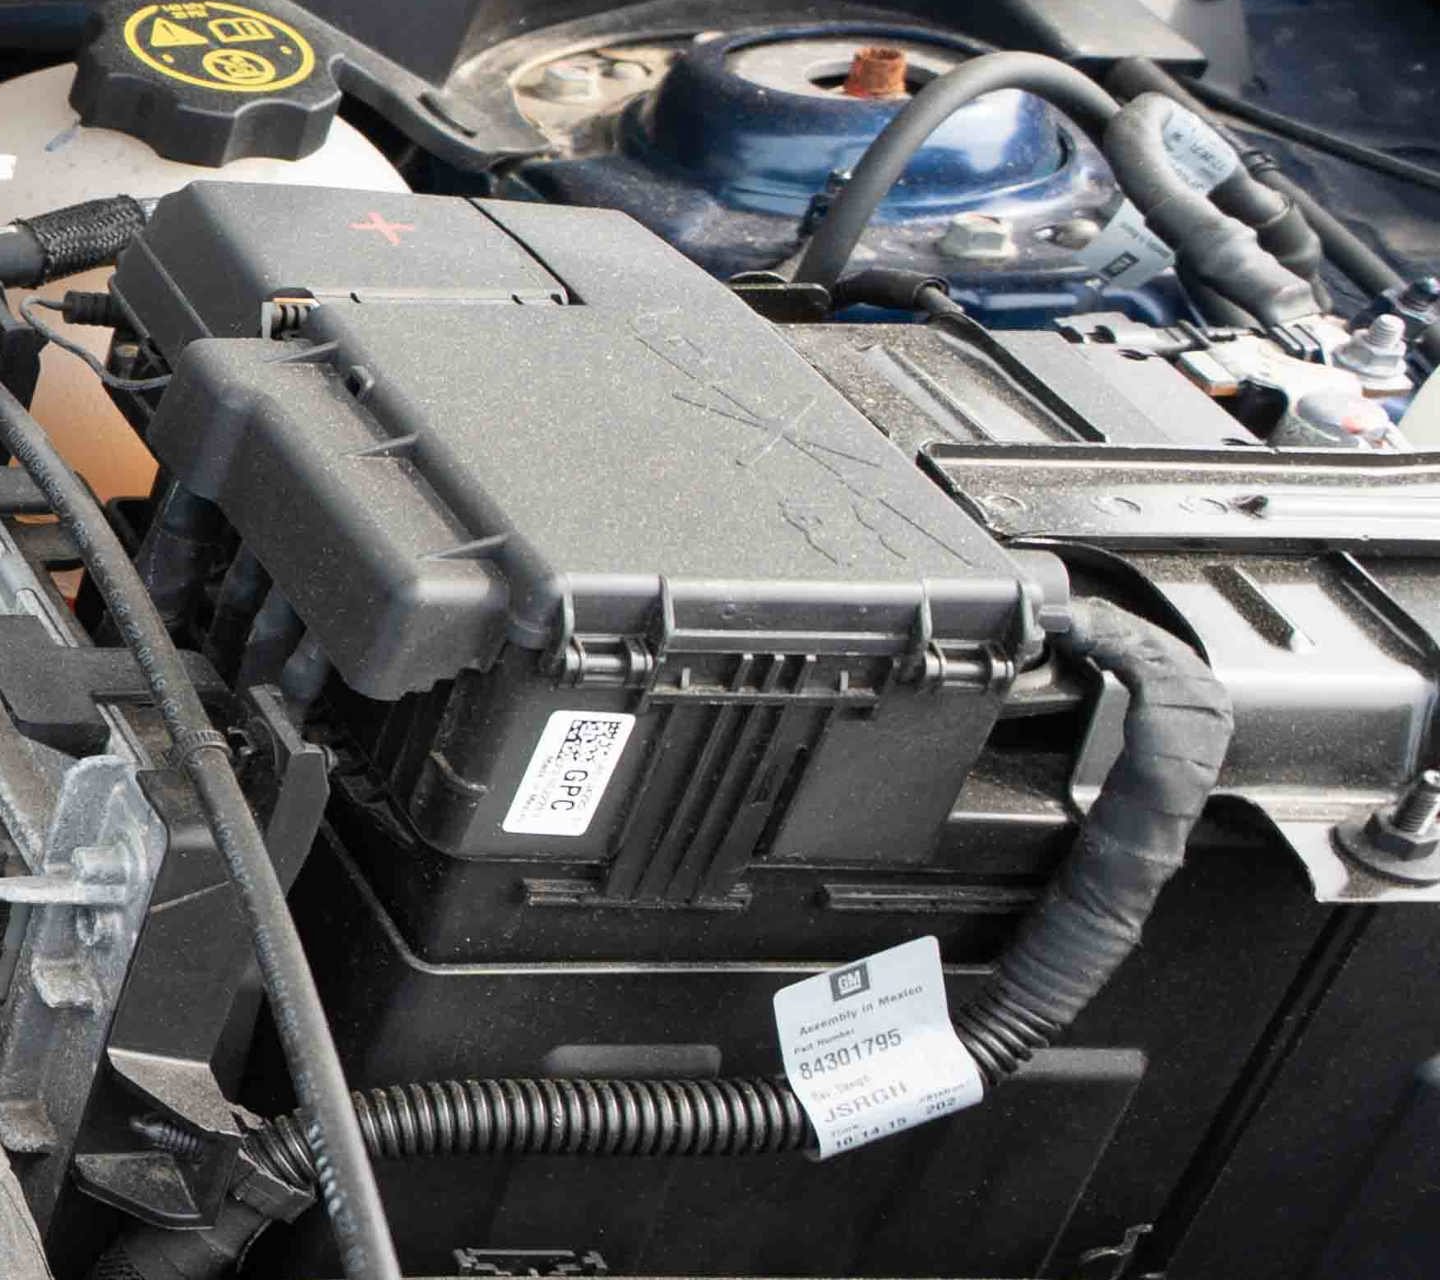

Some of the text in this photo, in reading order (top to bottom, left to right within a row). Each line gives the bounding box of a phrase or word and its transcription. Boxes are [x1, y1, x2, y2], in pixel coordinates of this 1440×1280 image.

[550, 769, 589, 811] GPC
[837, 969, 862, 995] GM
[800, 985, 923, 1036] Assembly in Mexico
[799, 1028, 902, 1080] 84301795
